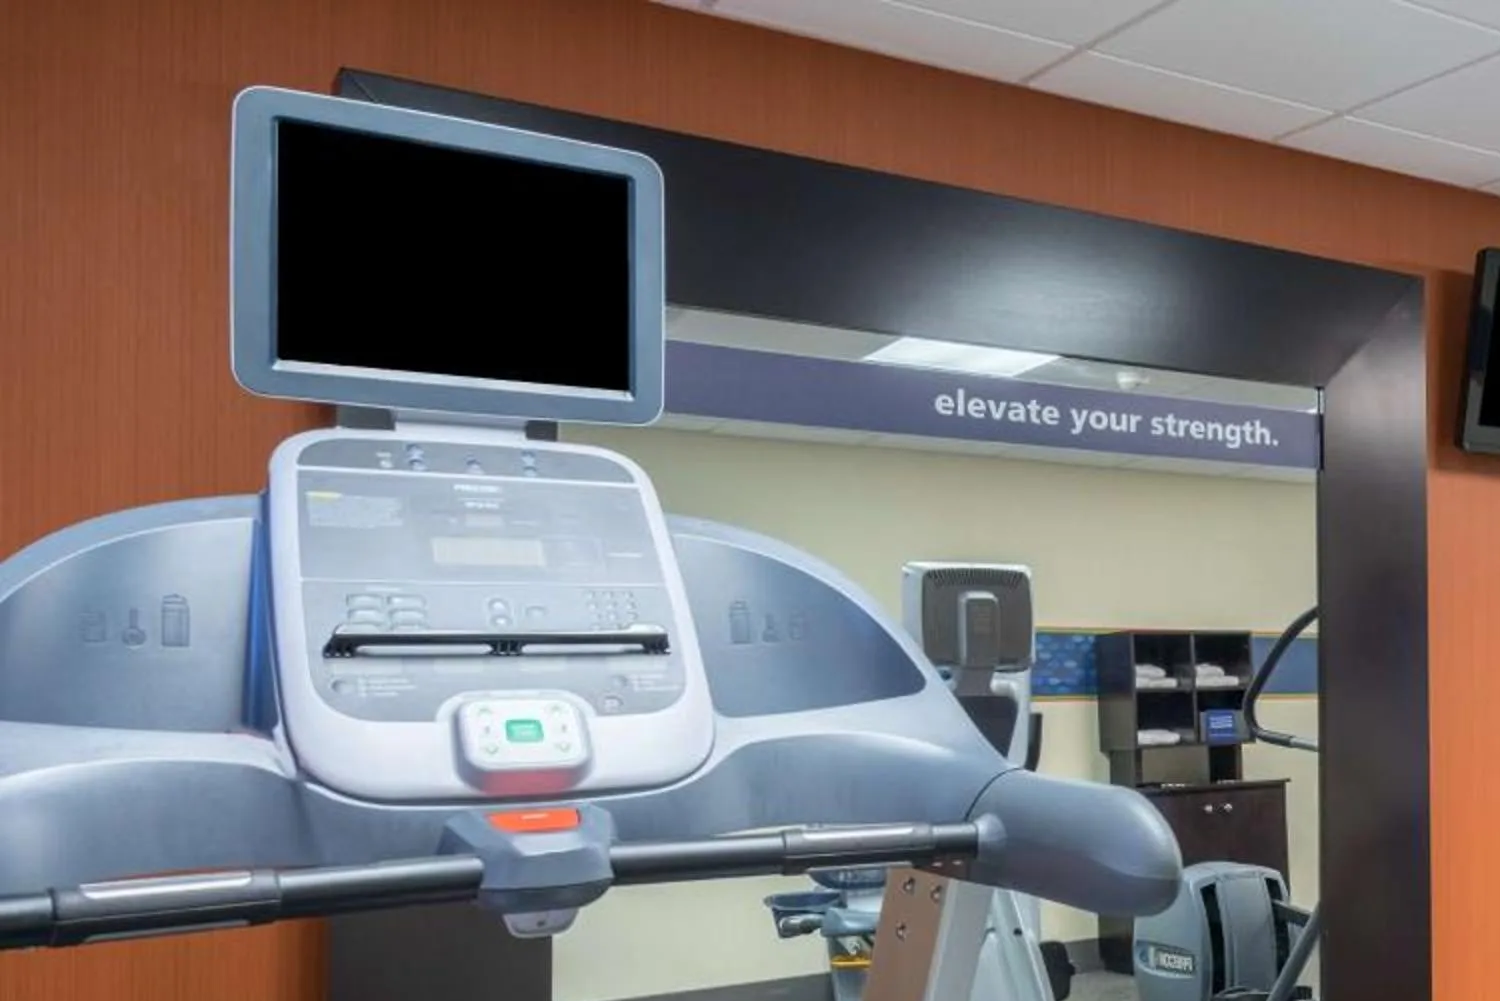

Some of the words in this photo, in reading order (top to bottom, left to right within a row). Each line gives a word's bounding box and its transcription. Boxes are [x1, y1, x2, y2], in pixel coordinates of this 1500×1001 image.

[934, 388, 1061, 426] elevate
[1070, 408, 1141, 435] your
[1150, 415, 1279, 449] strength.
